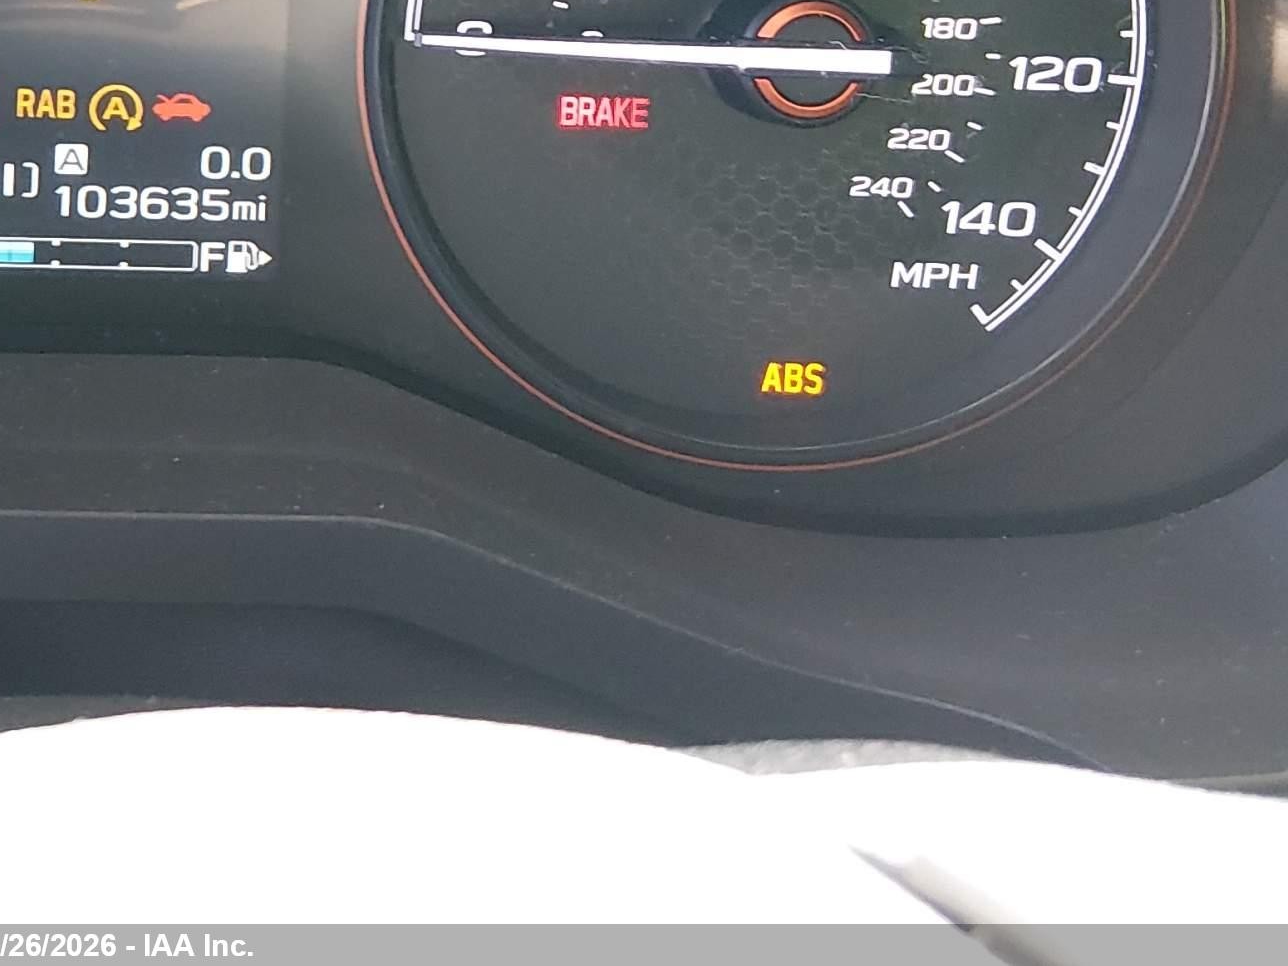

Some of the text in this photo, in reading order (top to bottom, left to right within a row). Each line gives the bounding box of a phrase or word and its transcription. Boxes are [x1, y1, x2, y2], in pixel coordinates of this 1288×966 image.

[921, 17, 978, 40] 180
[910, 73, 976, 97] 200
[1008, 55, 1104, 93] 120
[16, 88, 76, 119] RAB
[557, 95, 650, 130] BRAKE
[887, 127, 952, 151] 220
[200, 145, 272, 181] 0.0
[849, 175, 915, 199] 240
[941, 200, 1037, 237] 140
[198, 241, 225, 274] F
[890, 261, 979, 290] MPH
[761, 362, 826, 395] ABS
